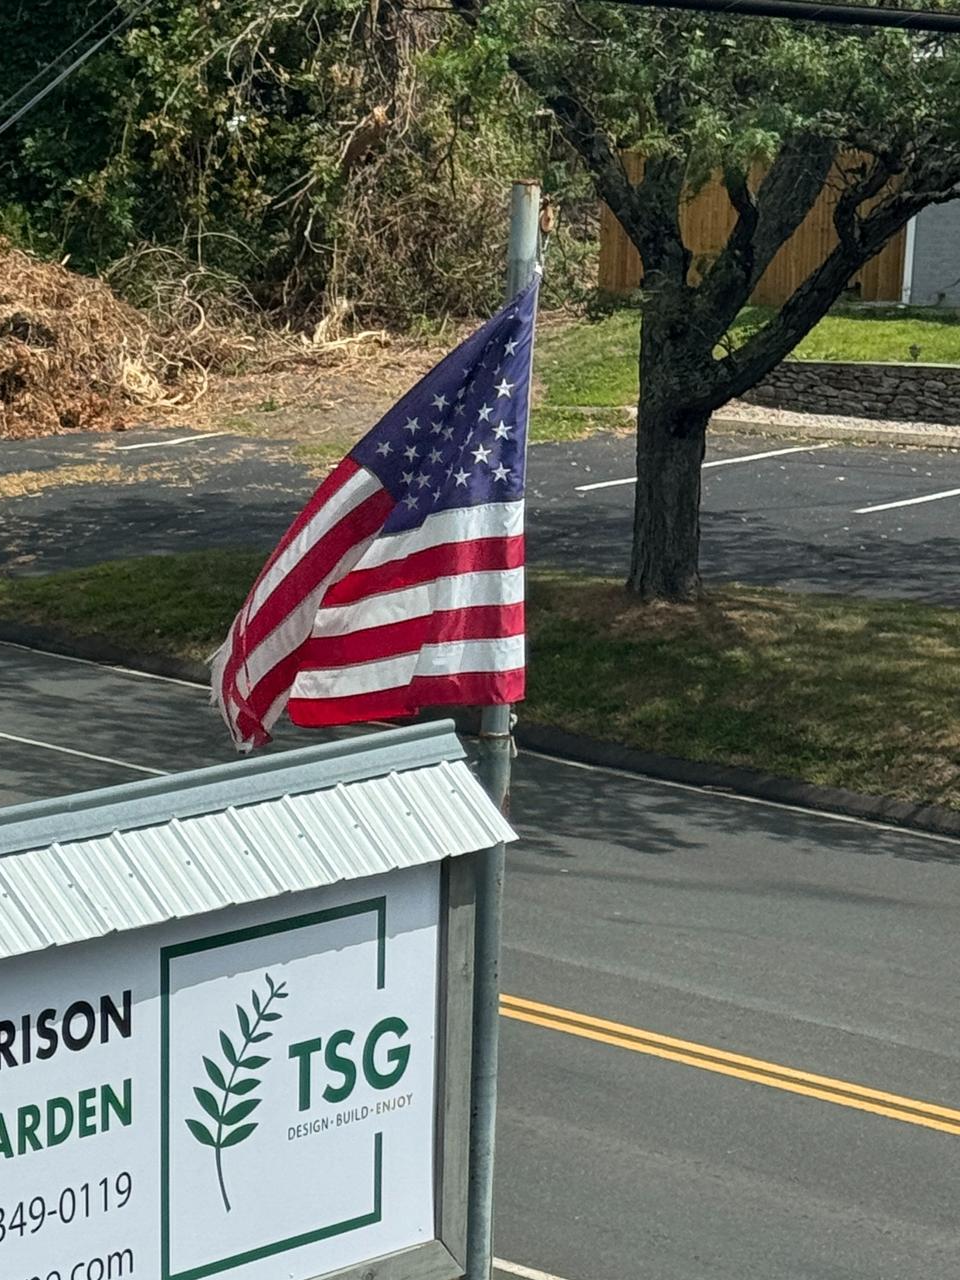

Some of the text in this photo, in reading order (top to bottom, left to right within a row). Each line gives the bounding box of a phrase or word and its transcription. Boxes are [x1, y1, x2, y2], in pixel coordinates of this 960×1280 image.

[288, 1016, 411, 1112] TSG
[287, 1093, 413, 1141] DESIGN BUILD ENJOY
